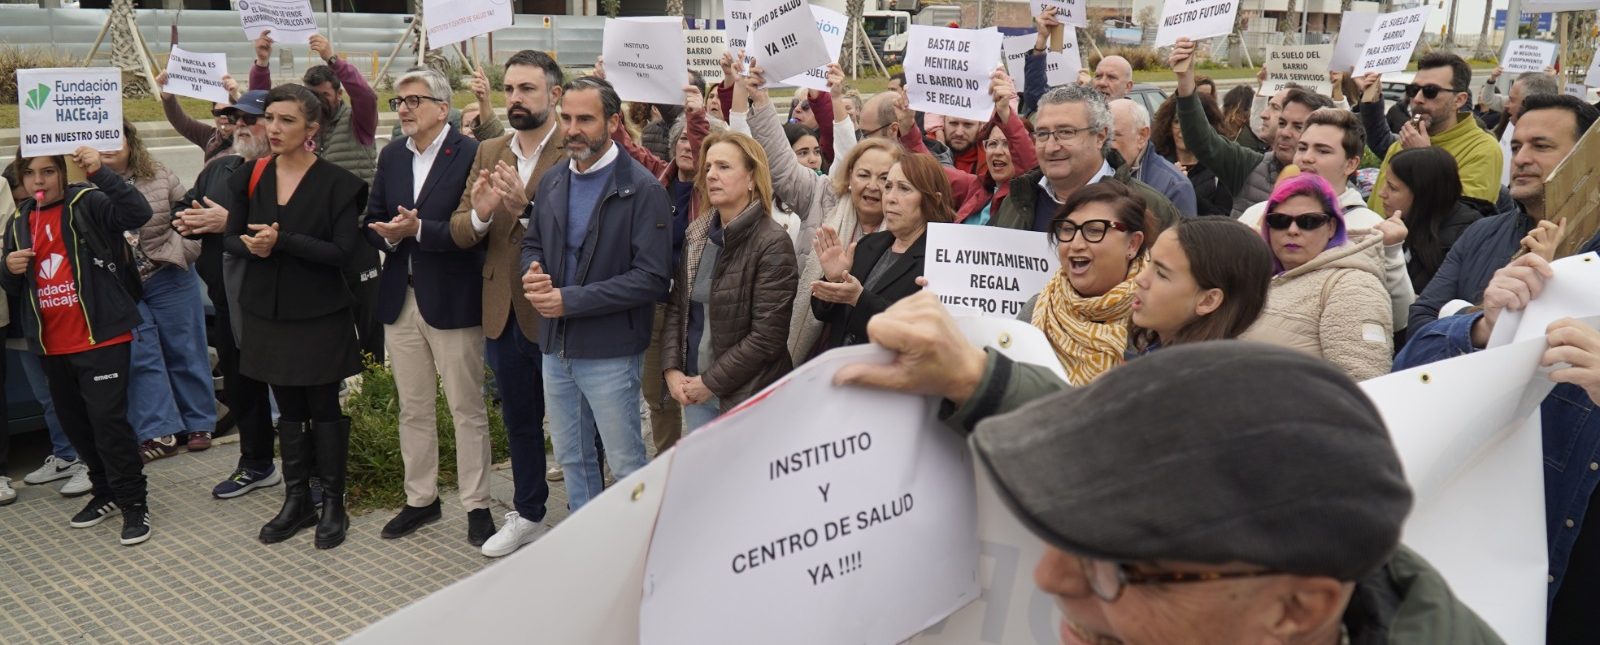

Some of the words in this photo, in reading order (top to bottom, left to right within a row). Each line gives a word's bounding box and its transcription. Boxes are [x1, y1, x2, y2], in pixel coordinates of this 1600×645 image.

[731, 11, 747, 20] ESTA
[769, 8, 779, 20] DE
[778, 0, 802, 15] SALUD
[1163, 9, 1198, 28] NUESTRO
[1198, 2, 1232, 20] FUTURO
[1388, 16, 1409, 28] SUELO
[1408, 13, 1421, 24] DEL
[1382, 29, 1405, 41] BARRIO
[623, 42, 650, 50] INSTITUTO
[686, 47, 713, 55] BARRIO
[764, 42, 780, 57] YA
[781, 33, 798, 49] !!!!
[927, 37, 955, 52] BASTA
[957, 40, 971, 53] DE
[1365, 46, 1381, 57] PARA
[1380, 40, 1412, 54] SERVICIOS
[182, 57, 206, 67] PARCELA
[1281, 51, 1304, 59] SUELO
[1306, 51, 1320, 59] DEL
[181, 65, 207, 75] NUESTRA
[617, 60, 638, 68] CENTRO
[646, 63, 664, 71] SALUD
[924, 55, 969, 72] MENTIRAS
[1282, 62, 1308, 71] BARRIO
[1364, 59, 1376, 69] DEL
[916, 73, 928, 85] EL
[929, 74, 963, 89] BARRIO
[966, 78, 979, 91] NO
[1270, 72, 1288, 80] PARA
[1289, 73, 1325, 82] SERVICIOS
[55, 79, 118, 92] Fundación
[191, 83, 202, 92] YA!
[55, 93, 102, 108] Unicaja
[926, 91, 937, 103] SE
[938, 92, 972, 109] REGALA
[55, 107, 109, 124] HACEcaja
[25, 134, 39, 144] NO
[40, 133, 52, 144] EN
[54, 131, 93, 143] NUESTRO
[94, 129, 120, 140] SUELO
[935, 248, 951, 263] EL
[955, 249, 1049, 273] AYUNTAMIENTO
[970, 273, 1020, 292] REGALA
[769, 431, 873, 481] INSTITUTO
[818, 482, 831, 503] Y
[731, 528, 819, 575] CENTRO
[824, 516, 852, 542] DE
[856, 492, 915, 531] SALUD
[807, 562, 835, 587] YA
[838, 550, 863, 577] !!!!
